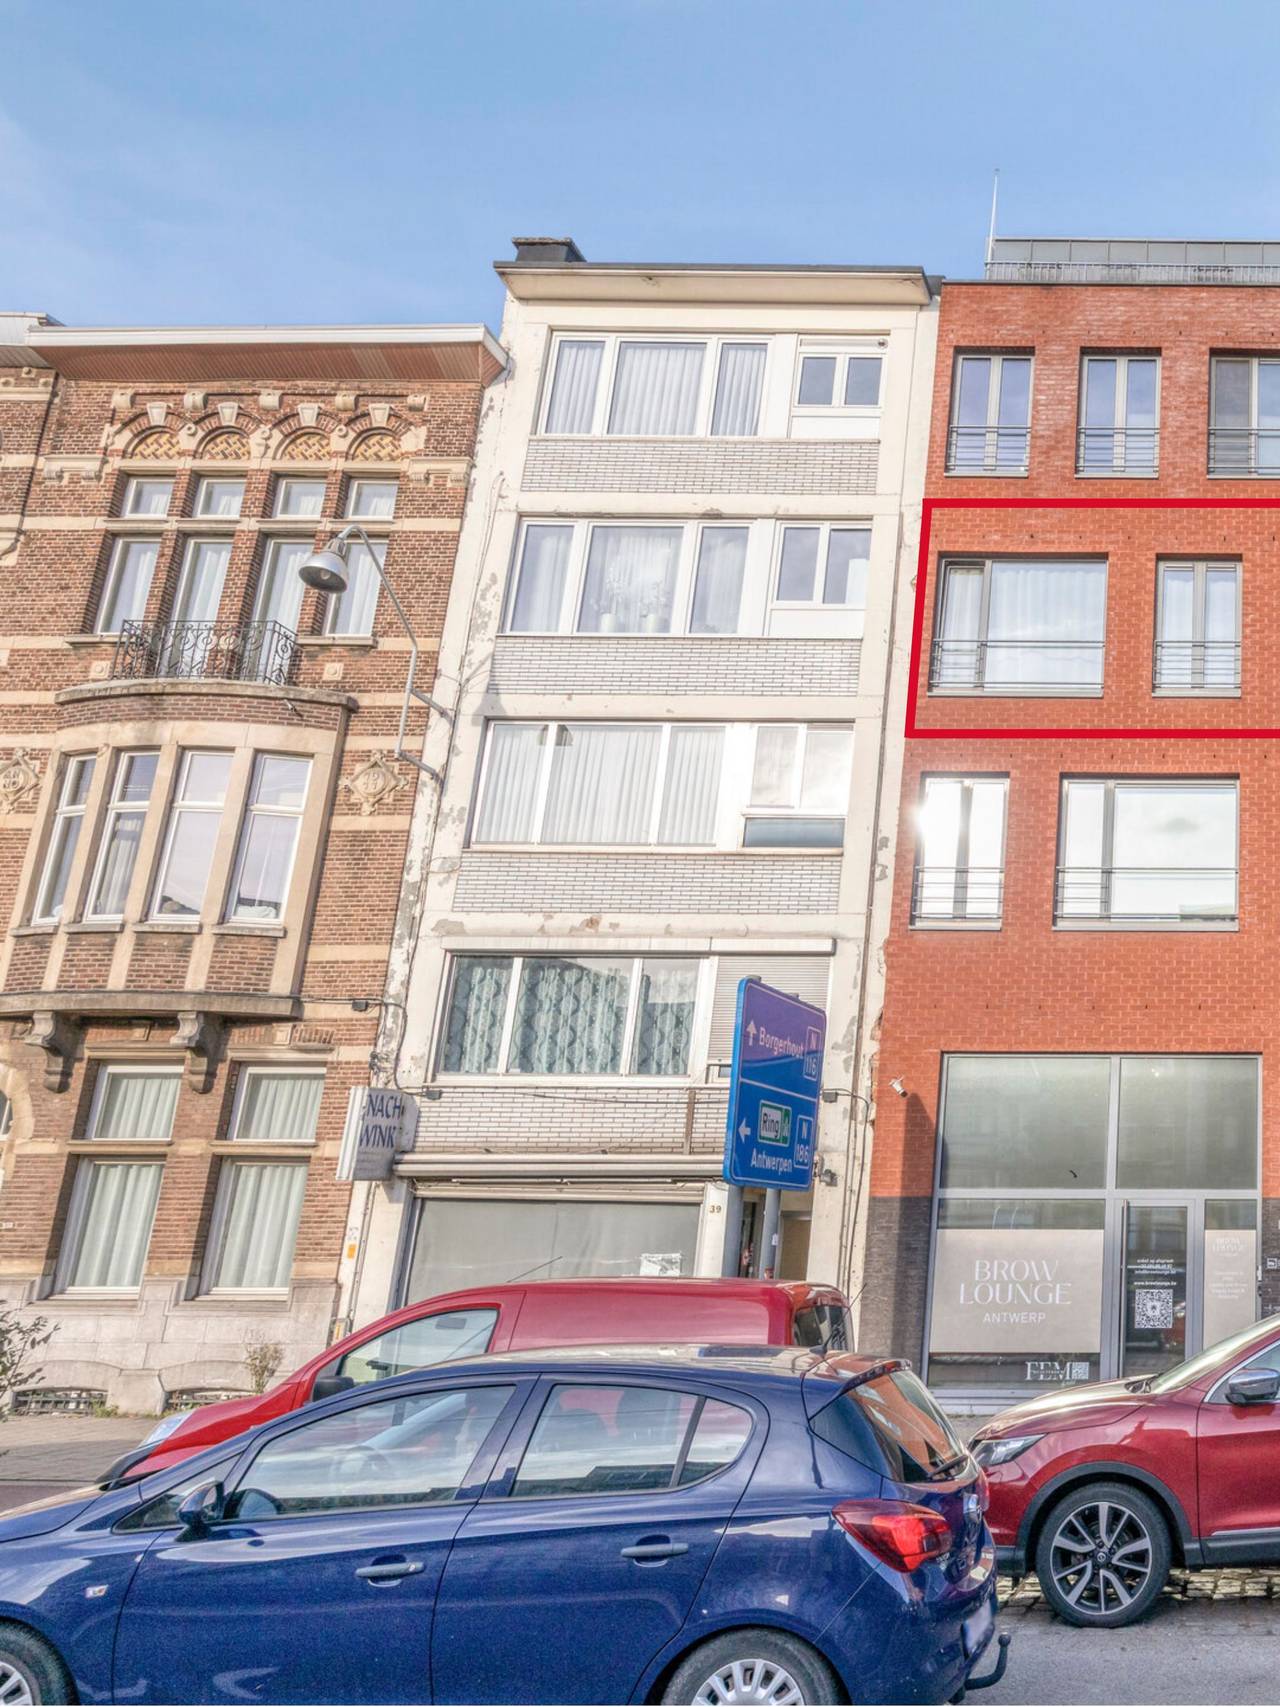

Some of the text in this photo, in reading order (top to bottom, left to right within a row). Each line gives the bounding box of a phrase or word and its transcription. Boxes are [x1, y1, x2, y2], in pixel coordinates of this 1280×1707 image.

[760, 1026, 804, 1058] Borgerhout
[810, 1032, 817, 1049] N
[762, 1112, 779, 1139] Ring
[801, 1120, 808, 1139] N
[751, 1147, 792, 1175] Antwerpen
[709, 1205, 722, 1213] 39
[975, 1259, 1059, 1281] BROW
[959, 1283, 1073, 1305] LOUNGE
[983, 1312, 1047, 1324] ANTWERP
